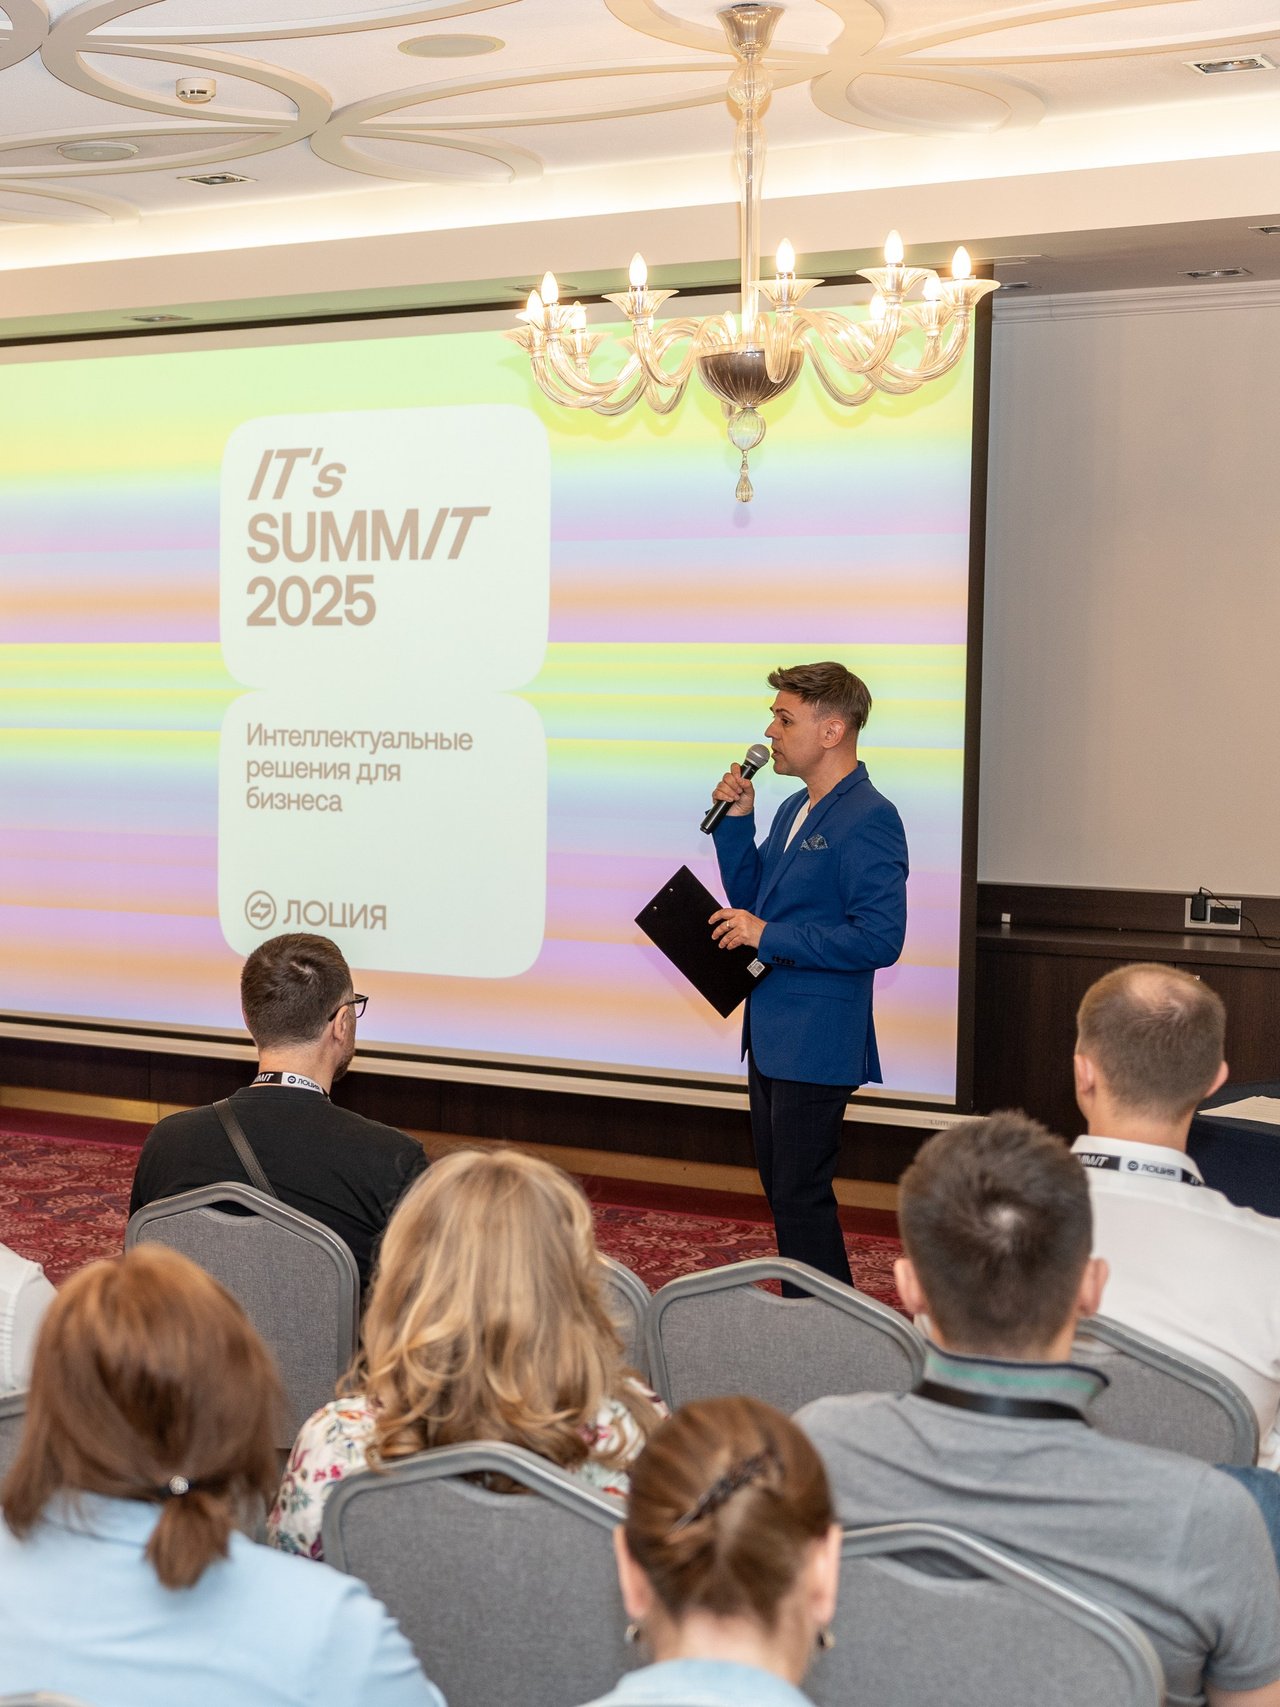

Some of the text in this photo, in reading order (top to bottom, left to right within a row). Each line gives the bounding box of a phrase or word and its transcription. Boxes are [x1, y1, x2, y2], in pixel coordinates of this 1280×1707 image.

[247, 447, 347, 501] IT's
[246, 506, 492, 564] SUMMIT
[246, 574, 377, 627] 2025
[246, 722, 474, 755] Интеллектуальные
[246, 759, 402, 785] решения для
[246, 787, 343, 812] бизнеса
[282, 899, 388, 931] ЛОЦИЯ
